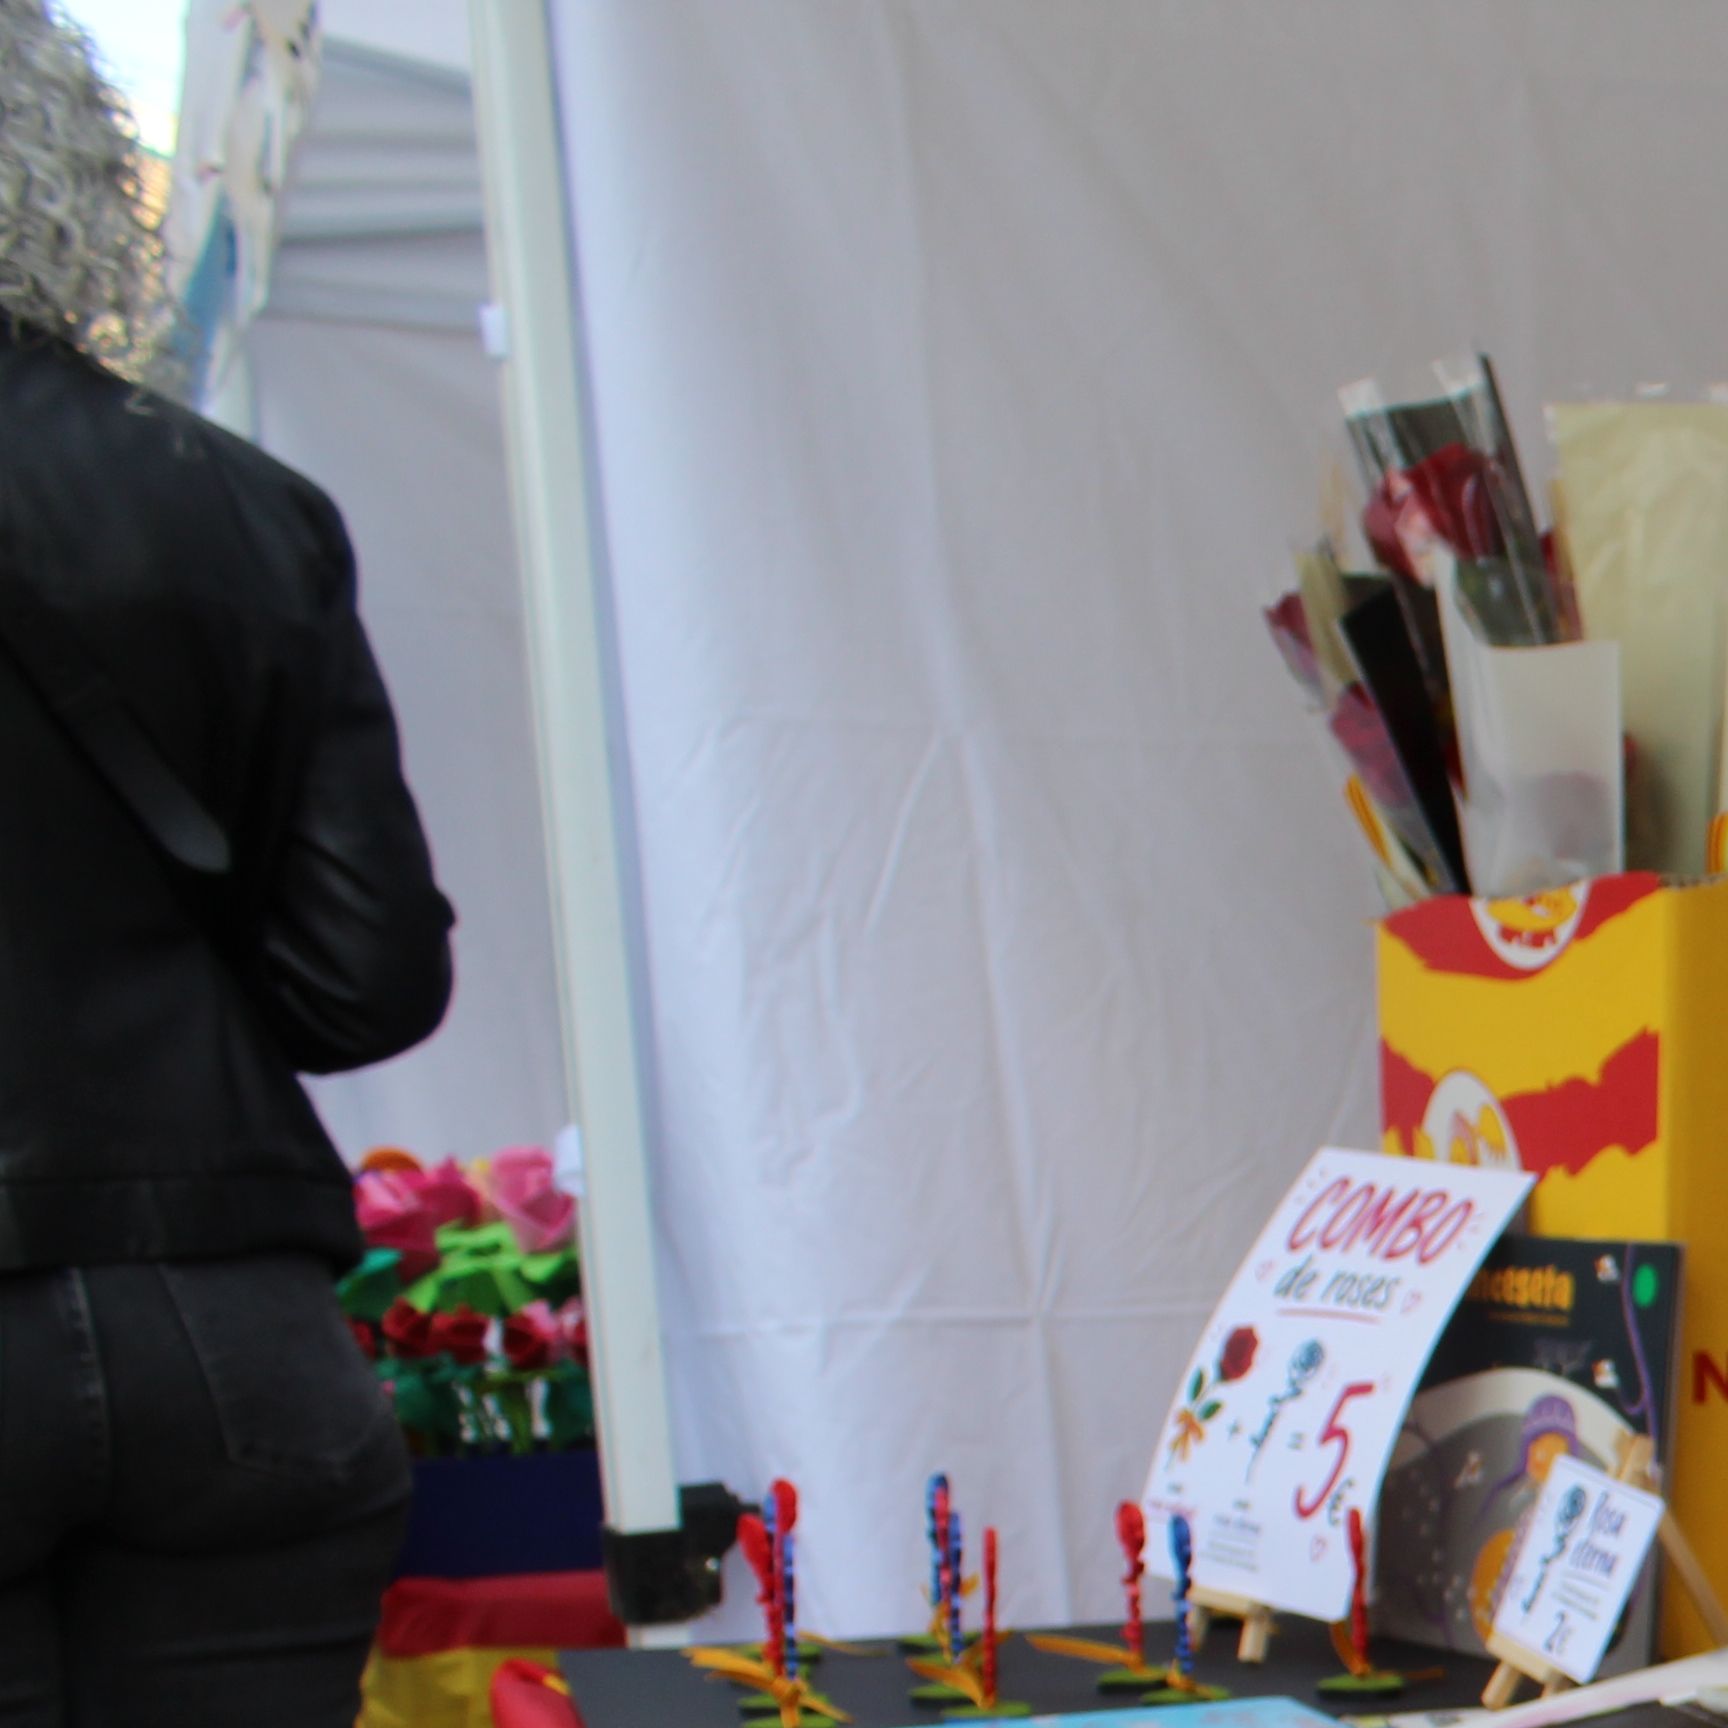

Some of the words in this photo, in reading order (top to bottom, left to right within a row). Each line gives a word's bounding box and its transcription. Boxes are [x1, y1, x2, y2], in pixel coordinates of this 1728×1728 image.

[1287, 1176, 1474, 1265] COMBO
[1274, 1254, 1317, 1301] de
[1320, 1270, 1402, 1310] roses
